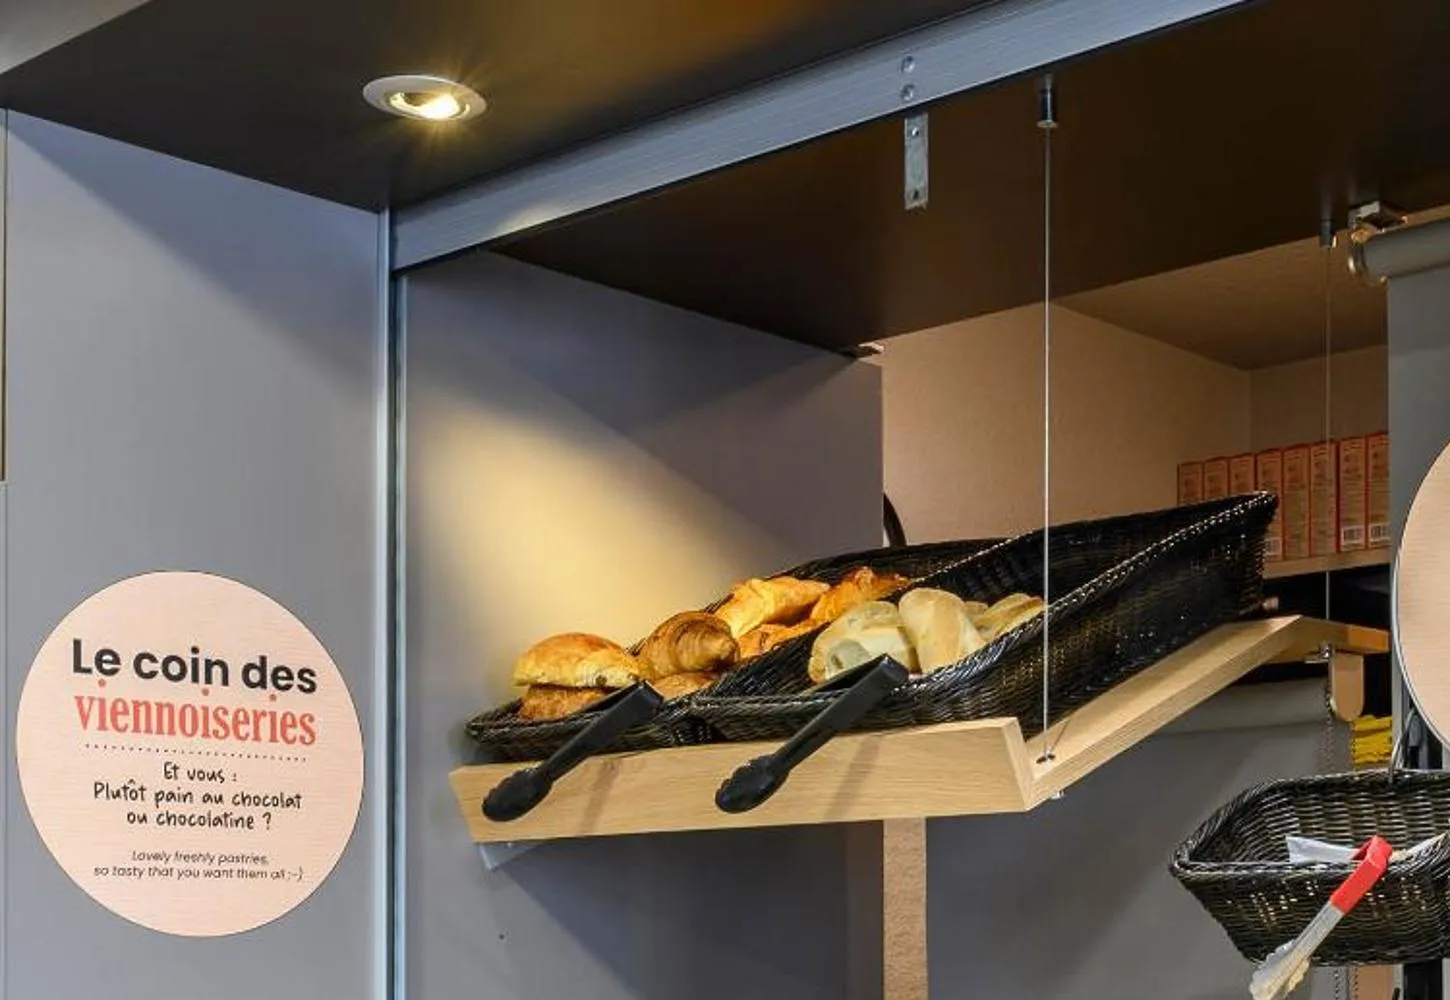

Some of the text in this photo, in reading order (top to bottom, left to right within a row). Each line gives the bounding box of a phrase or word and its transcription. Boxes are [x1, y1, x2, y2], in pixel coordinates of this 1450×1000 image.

[72, 638, 317, 694] Le coin des
[74, 678, 316, 746] viennoiseries
[163, 762, 180, 781] Et
[187, 767, 225, 784] vous
[94, 779, 302, 809] Plutôt pain au chocolat
[126, 811, 272, 831] ou chocolatine ?
[131, 850, 172, 864] Lovely
[174, 851, 215, 865] freshly
[94, 866, 109, 876] so
[112, 865, 145, 879] tasty
[148, 866, 174, 877] that
[176, 867, 200, 880] you
[202, 867, 234, 879] want
[236, 866, 268, 879] them
